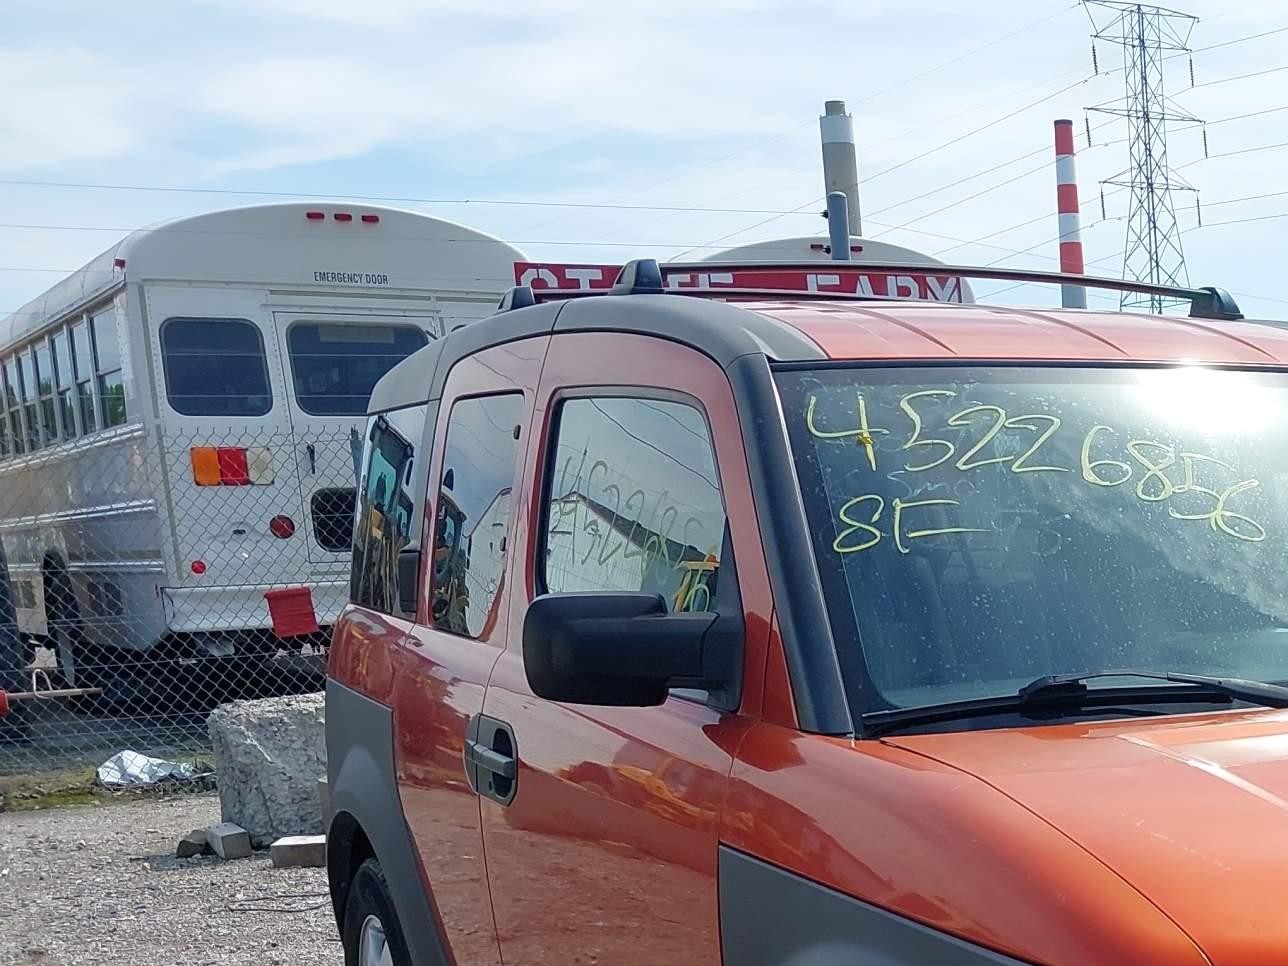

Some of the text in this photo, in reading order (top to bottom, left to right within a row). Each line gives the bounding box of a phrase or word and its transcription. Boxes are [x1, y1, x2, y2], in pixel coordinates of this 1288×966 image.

[313, 271, 389, 285] EMERGENCY DOOR
[806, 390, 1266, 542] 45226856
